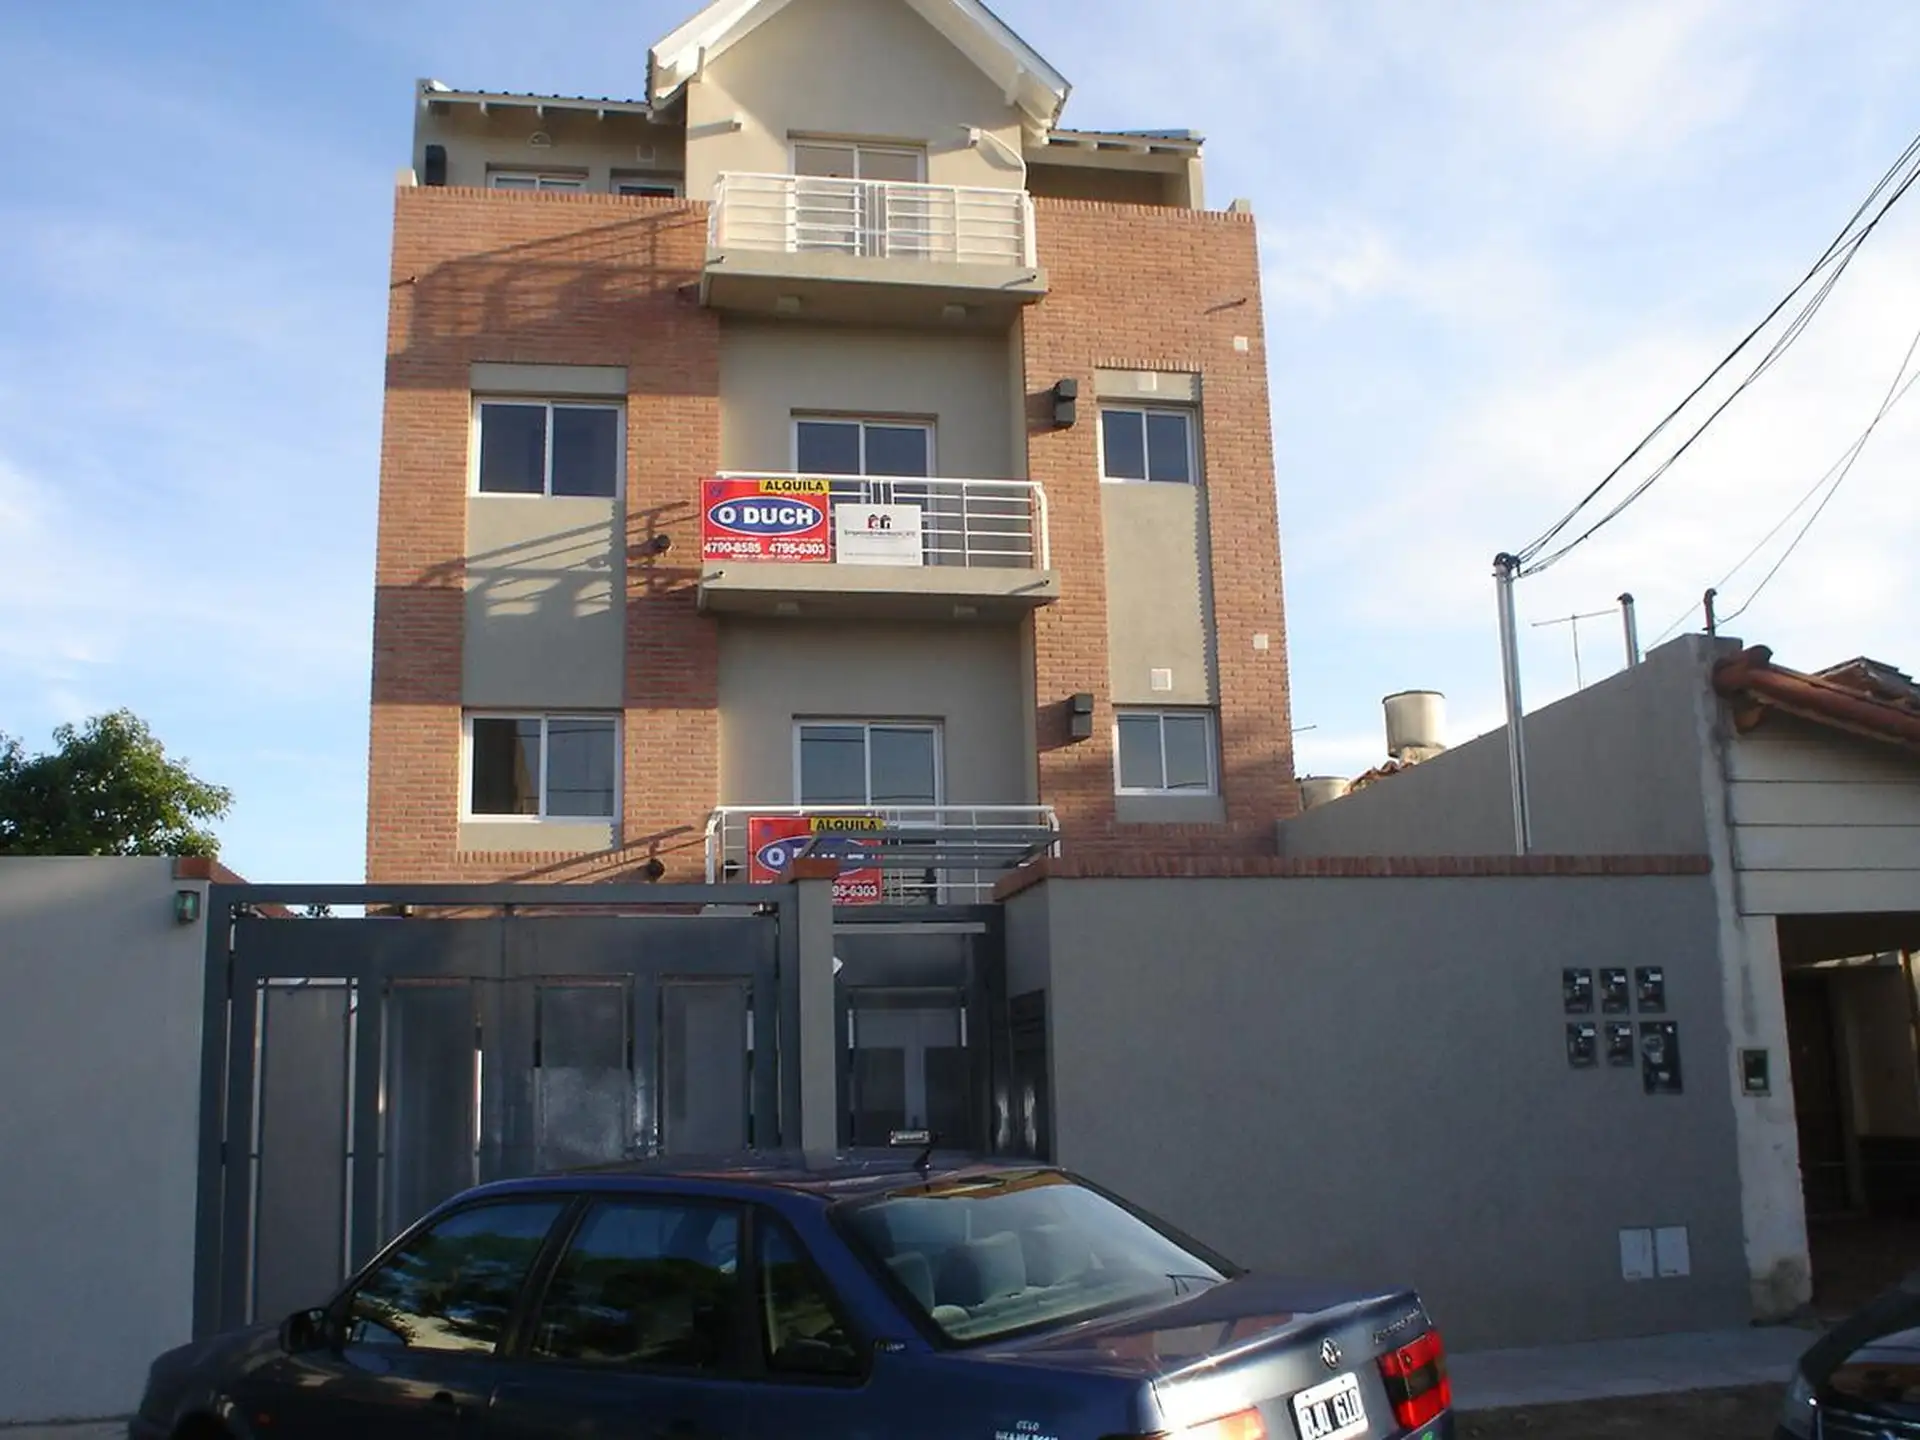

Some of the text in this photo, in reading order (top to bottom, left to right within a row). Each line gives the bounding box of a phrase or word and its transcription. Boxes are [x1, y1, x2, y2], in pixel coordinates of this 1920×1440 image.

[765, 480, 824, 492] ALQUILA
[768, 542, 826, 555] 4795-6303
[816, 819, 878, 832] ALQUILA
